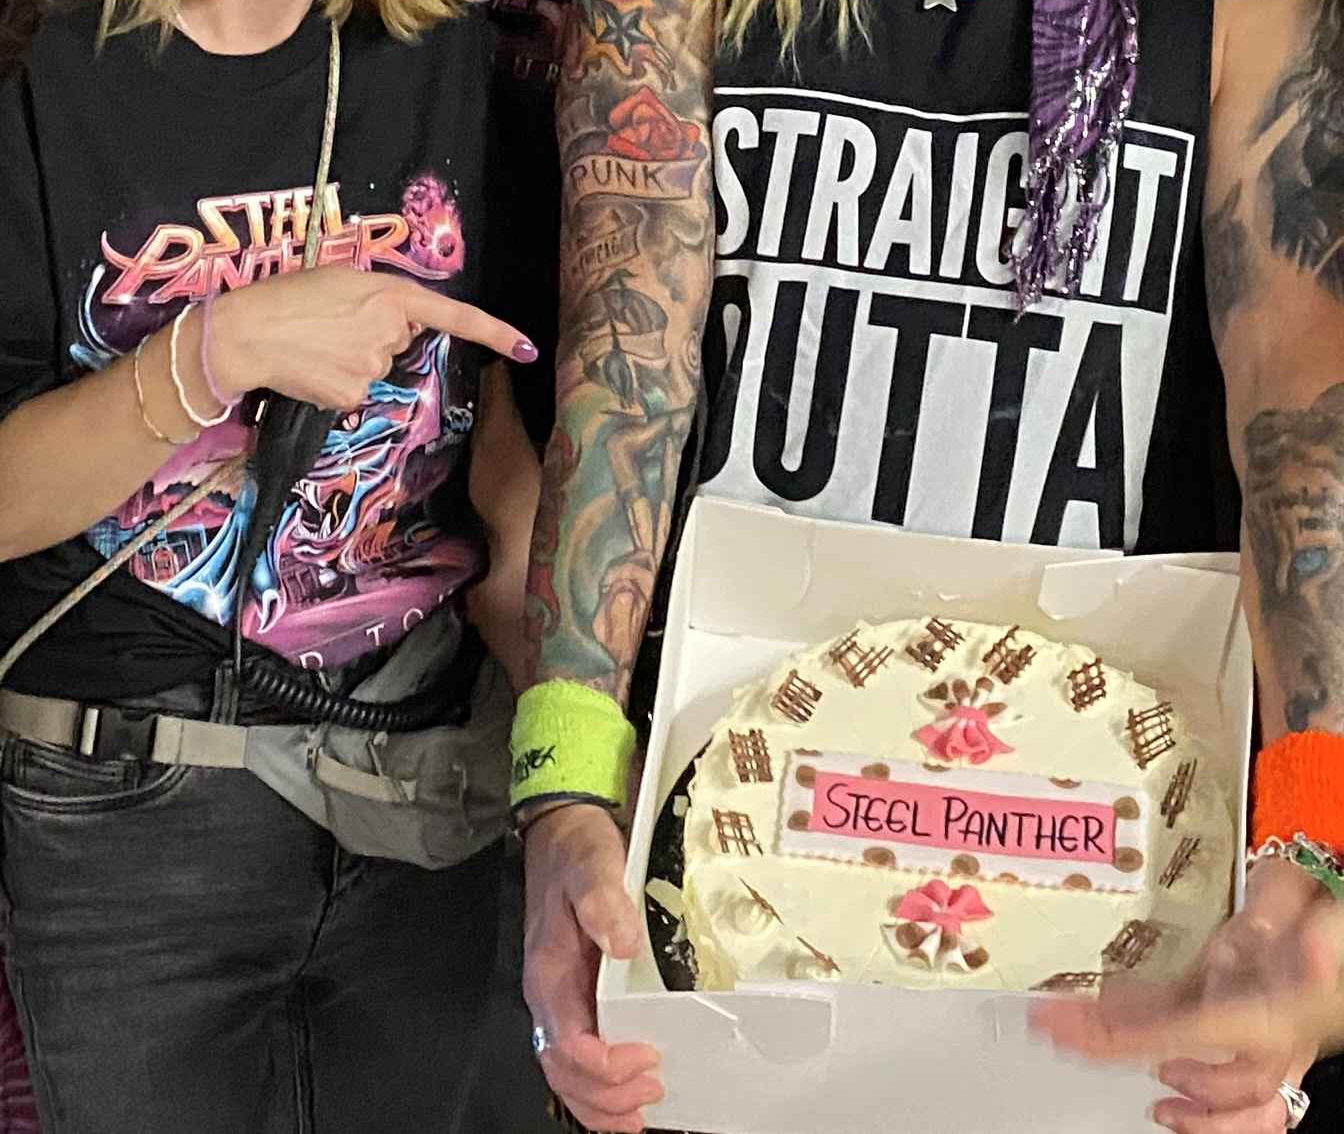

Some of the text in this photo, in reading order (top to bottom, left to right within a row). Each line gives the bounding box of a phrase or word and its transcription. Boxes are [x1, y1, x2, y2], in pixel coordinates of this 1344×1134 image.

[570, 159, 664, 193] PUNK
[822, 782, 1106, 855] STEEL PANTHER
